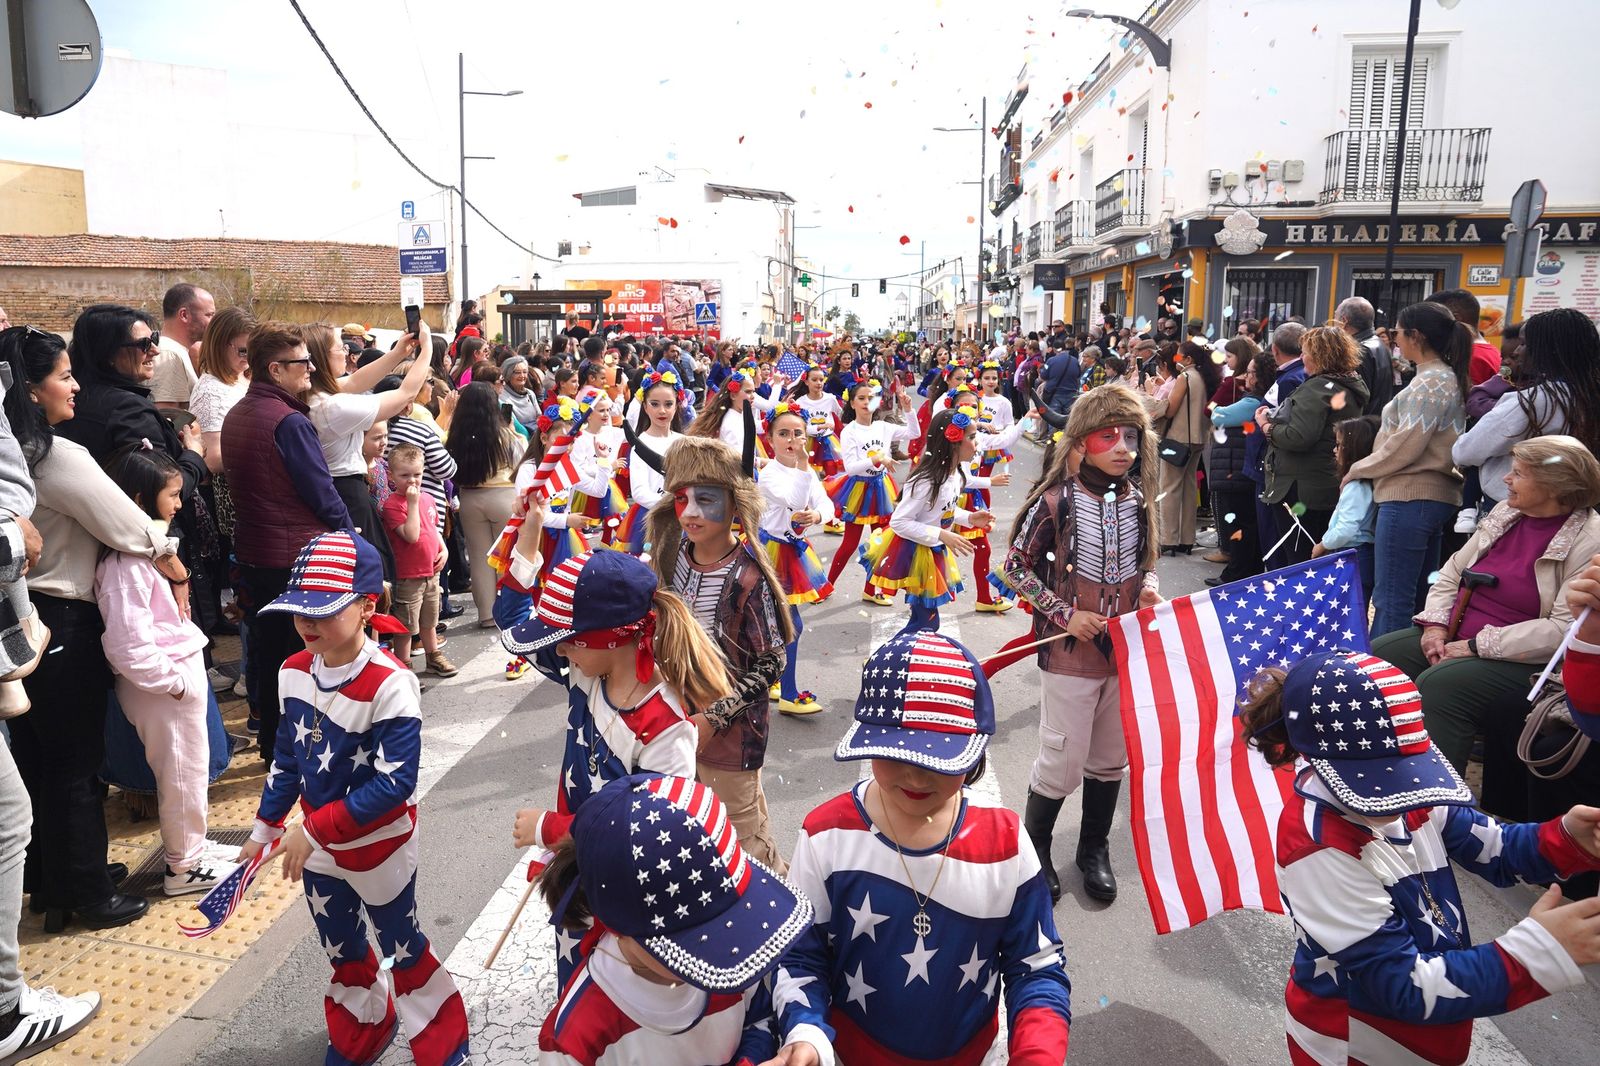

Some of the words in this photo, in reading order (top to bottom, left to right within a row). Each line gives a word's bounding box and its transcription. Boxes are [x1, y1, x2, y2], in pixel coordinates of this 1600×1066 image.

[1284, 219, 1481, 243] HELADERÍA
[1534, 222, 1600, 242] CAF
[618, 303, 664, 314] ALQUILER
